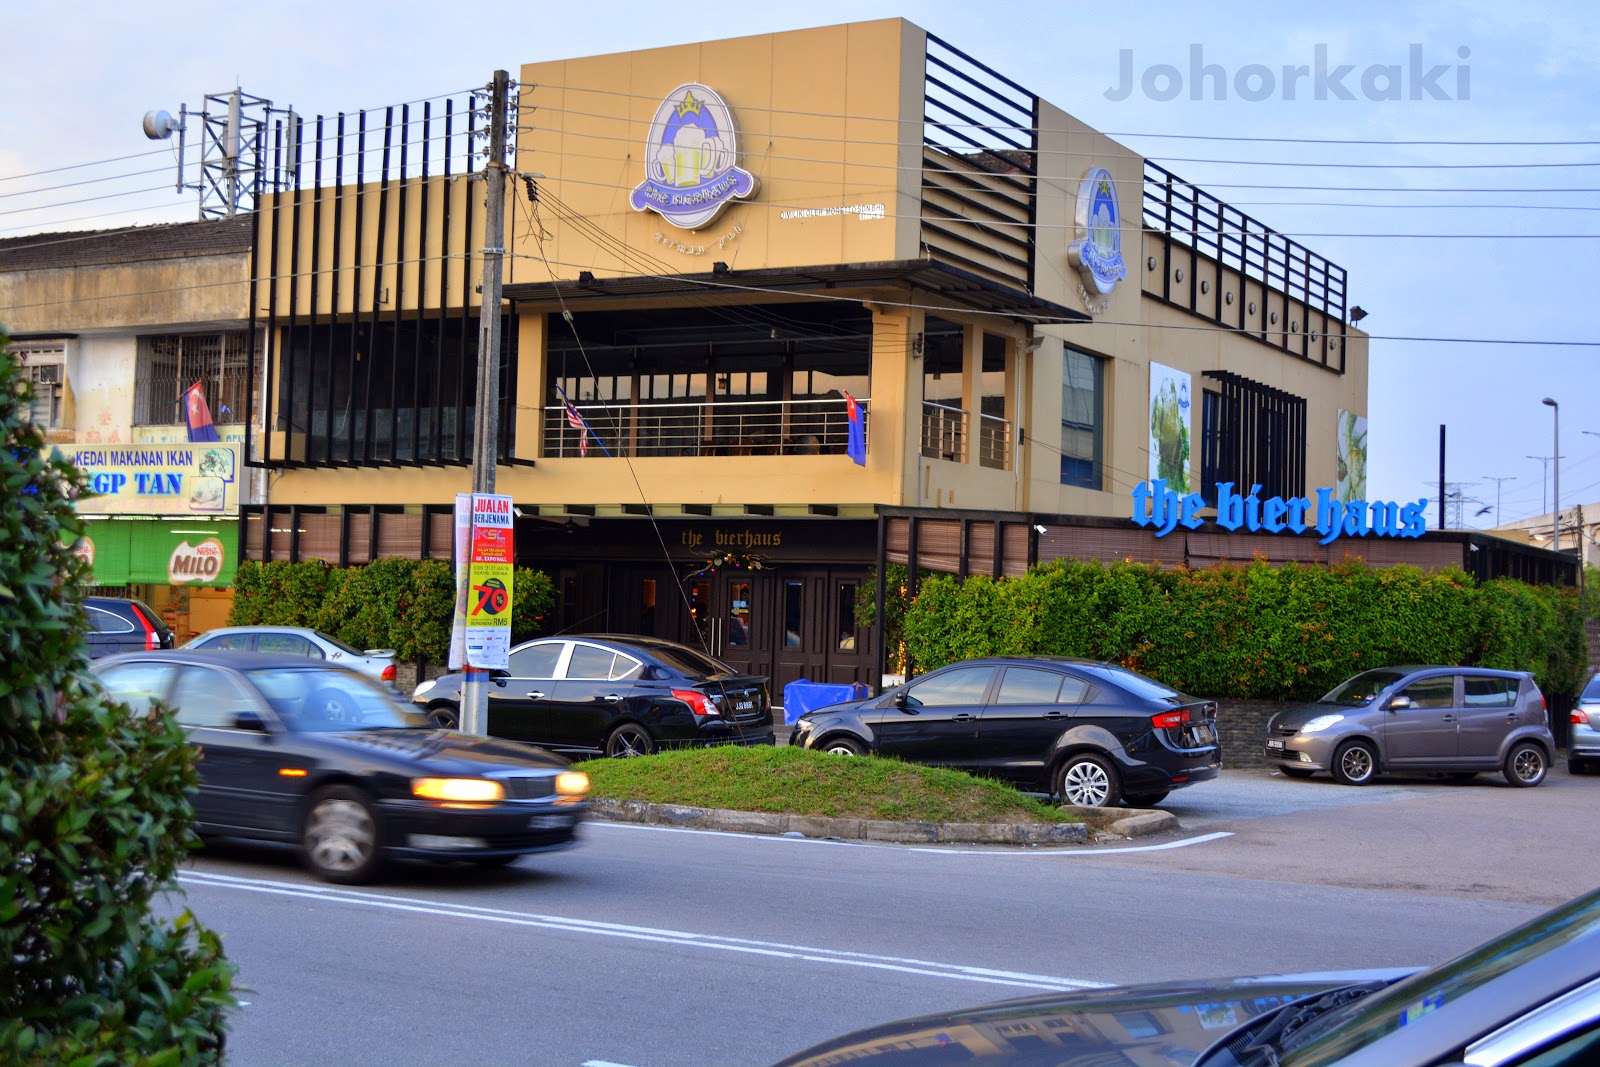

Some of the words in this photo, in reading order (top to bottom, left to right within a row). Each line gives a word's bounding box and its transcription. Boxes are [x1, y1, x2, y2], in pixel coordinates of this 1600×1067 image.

[76, 451, 107, 466] KEDAI
[111, 451, 163, 466] MAKANAN
[167, 451, 193, 466] IKAN
[134, 473, 183, 494] TAN
[475, 499, 509, 514] JUALAN
[1131, 478, 1206, 538] the
[474, 513, 510, 525] BERJENAMA
[681, 529, 703, 548] the
[715, 529, 782, 548] bierhaus
[173, 555, 218, 575] MILO
[493, 617, 508, 626] RM5
